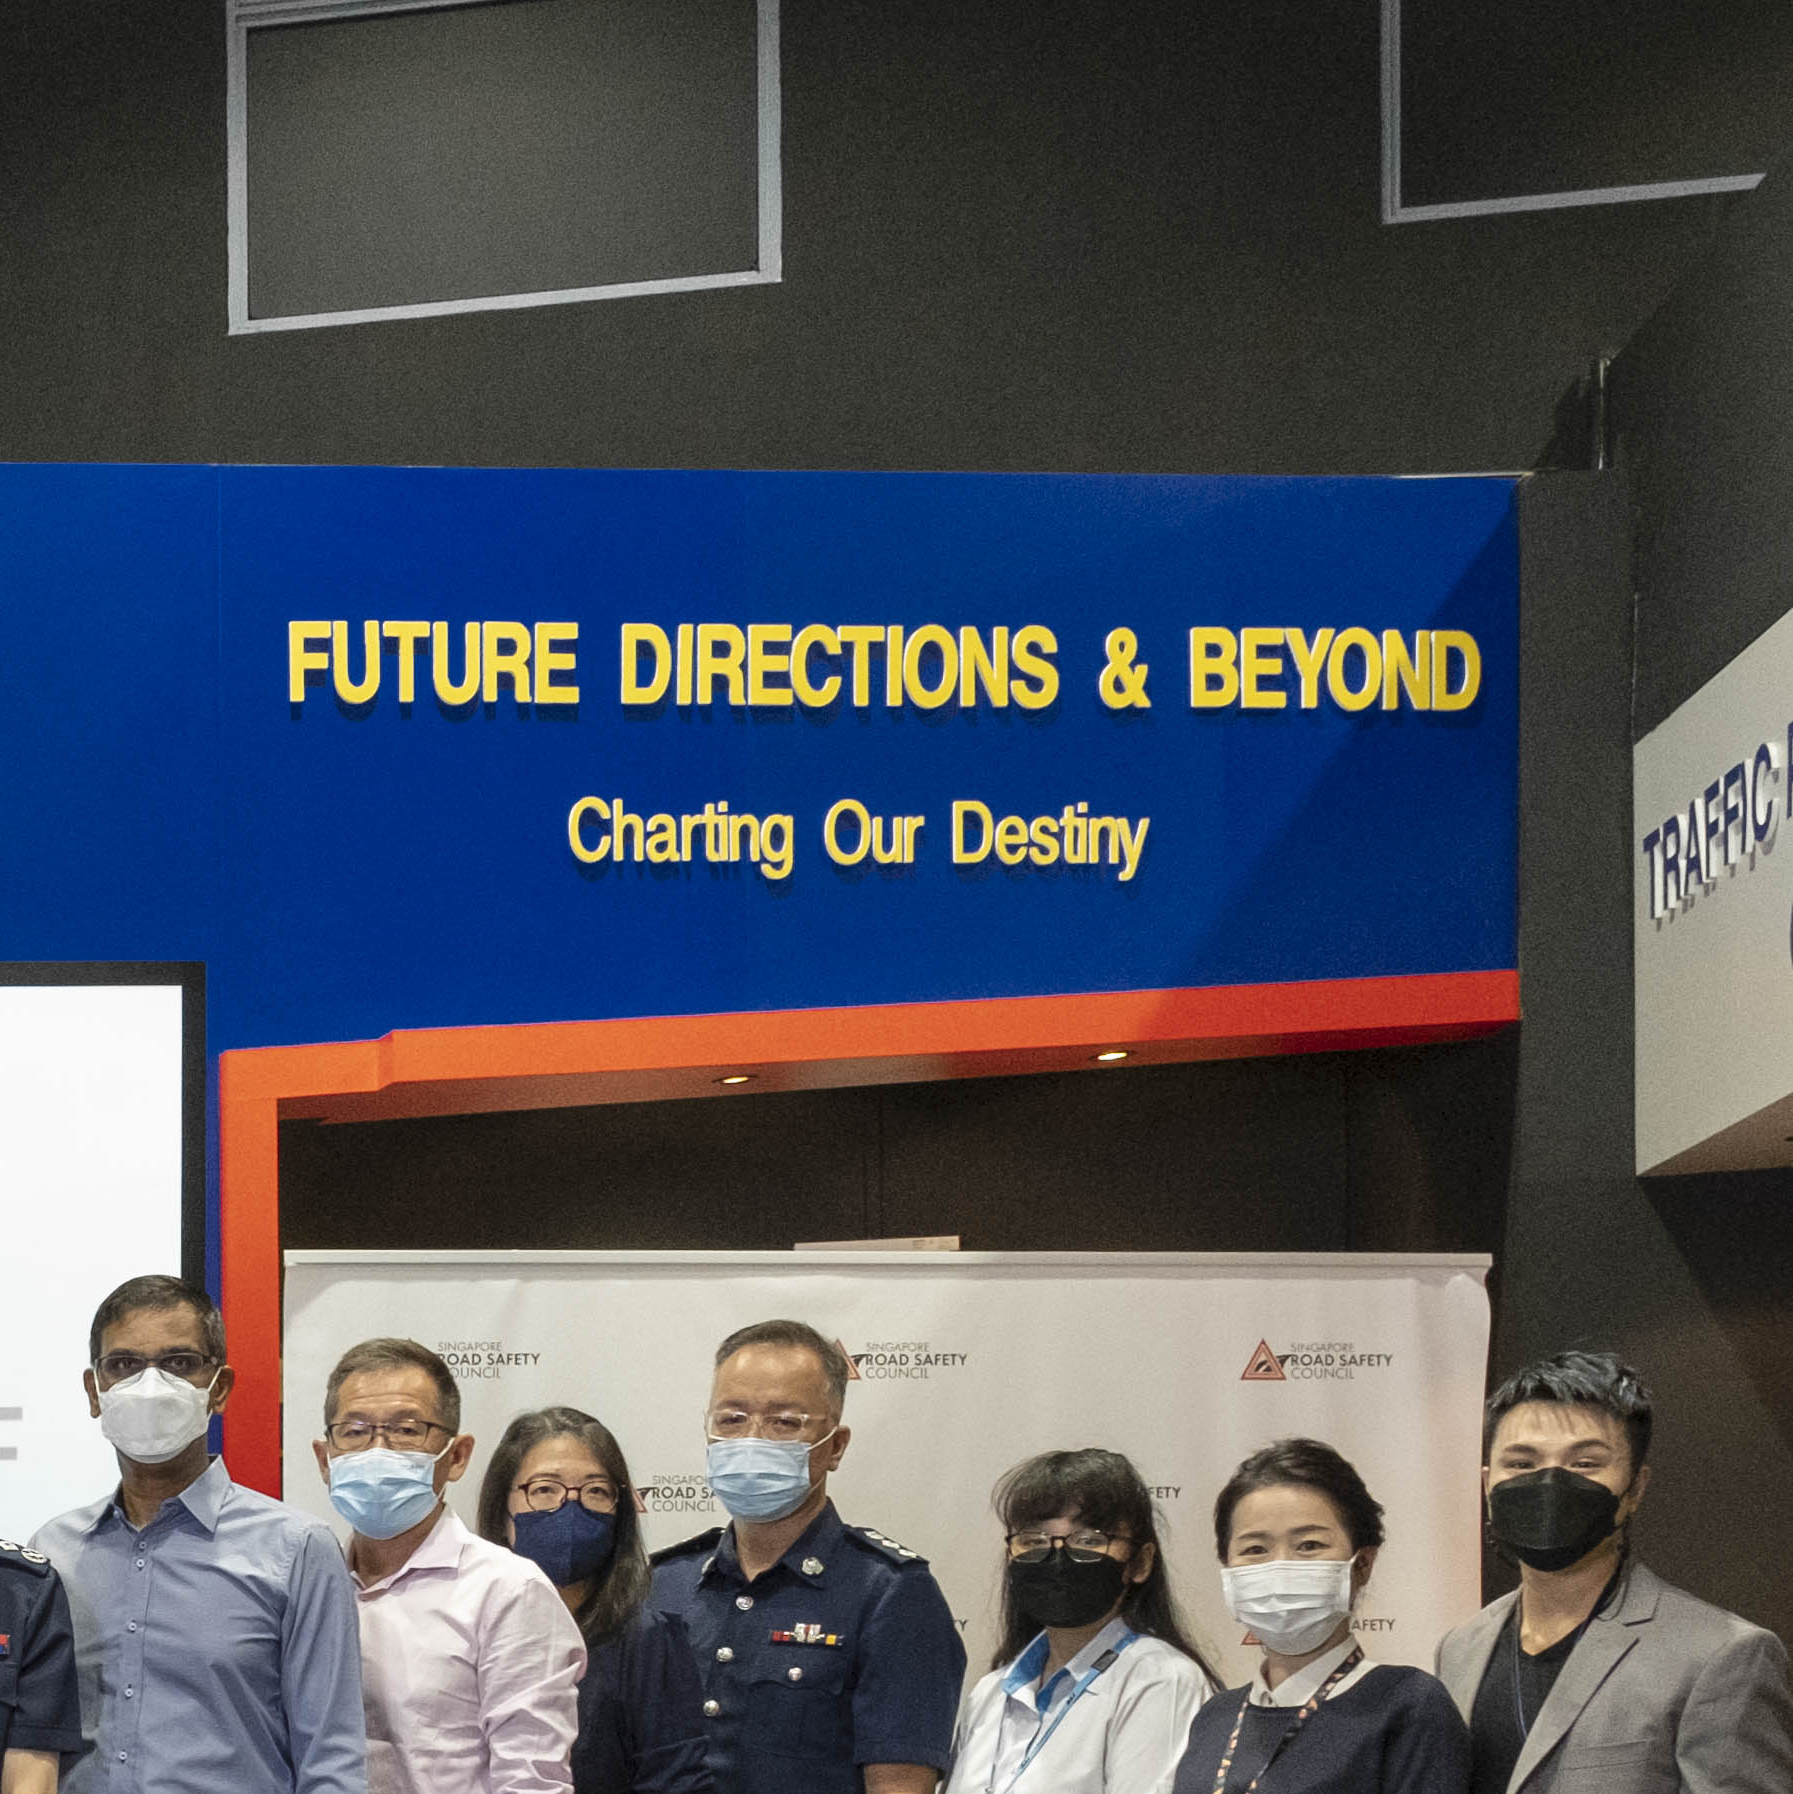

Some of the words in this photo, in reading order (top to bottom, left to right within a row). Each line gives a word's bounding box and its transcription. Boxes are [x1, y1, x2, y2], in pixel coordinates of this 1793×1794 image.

[288, 619, 579, 705] FUTURE
[620, 622, 1060, 709] DIRECTIONS
[1099, 626, 1151, 709] &
[1190, 626, 1482, 712] BEYOND
[1643, 742, 1779, 920] TRAFFIC
[568, 795, 795, 880] Charting
[823, 798, 924, 866] Our
[952, 799, 1150, 881] Destiny
[438, 1341, 502, 1352] SINGAPORE
[866, 1342, 930, 1352] SINGAPORE
[1291, 1342, 1355, 1352] SINGAPORE
[487, 1353, 541, 1366] SAFETY
[865, 1353, 909, 1366] ROAD
[914, 1353, 968, 1366] SAFETY
[1290, 1354, 1335, 1366] ROAD
[1339, 1354, 1394, 1367] SAFETY
[451, 1367, 501, 1379] OUNCIL
[865, 1367, 929, 1379] COUNCIL
[1290, 1367, 1355, 1379] COUNCIL
[651, 1486, 696, 1499] ROAD
[652, 1500, 717, 1512] COUNCIL
[1351, 1618, 1395, 1631] AFETY
